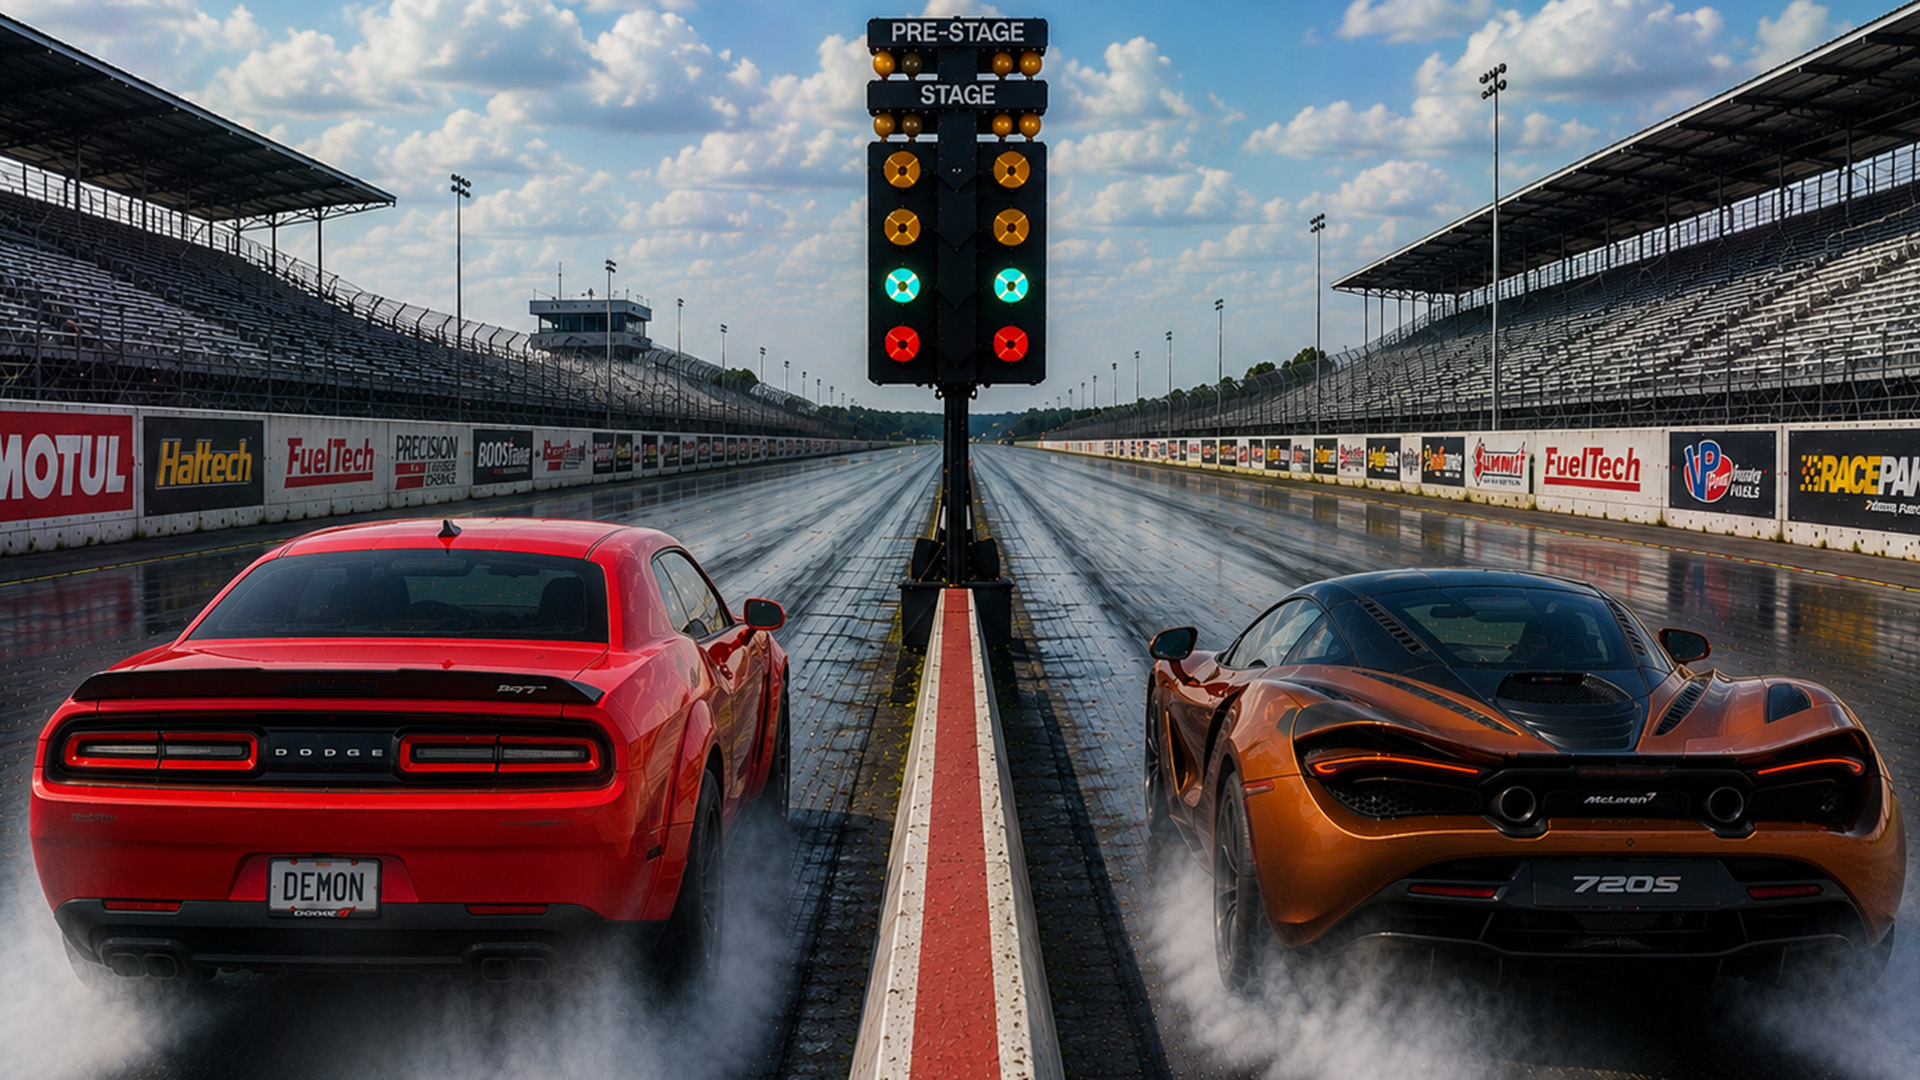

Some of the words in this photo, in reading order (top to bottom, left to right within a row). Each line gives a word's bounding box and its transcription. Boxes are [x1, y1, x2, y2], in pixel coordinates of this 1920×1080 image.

[891, 21, 1025, 43] PRE-STAGE
[920, 84, 996, 105] STAGE
[286, 437, 375, 475] FuelTech
[395, 434, 459, 461] PRECISION
[0, 433, 126, 499] MOTUL
[157, 440, 253, 487] Haltech
[1545, 447, 1641, 482] FuelTech
[1683, 439, 1722, 502] VP
[275, 748, 384, 757] DODGE
[283, 871, 364, 902] DEMON
[1573, 875, 1682, 893] 720S
